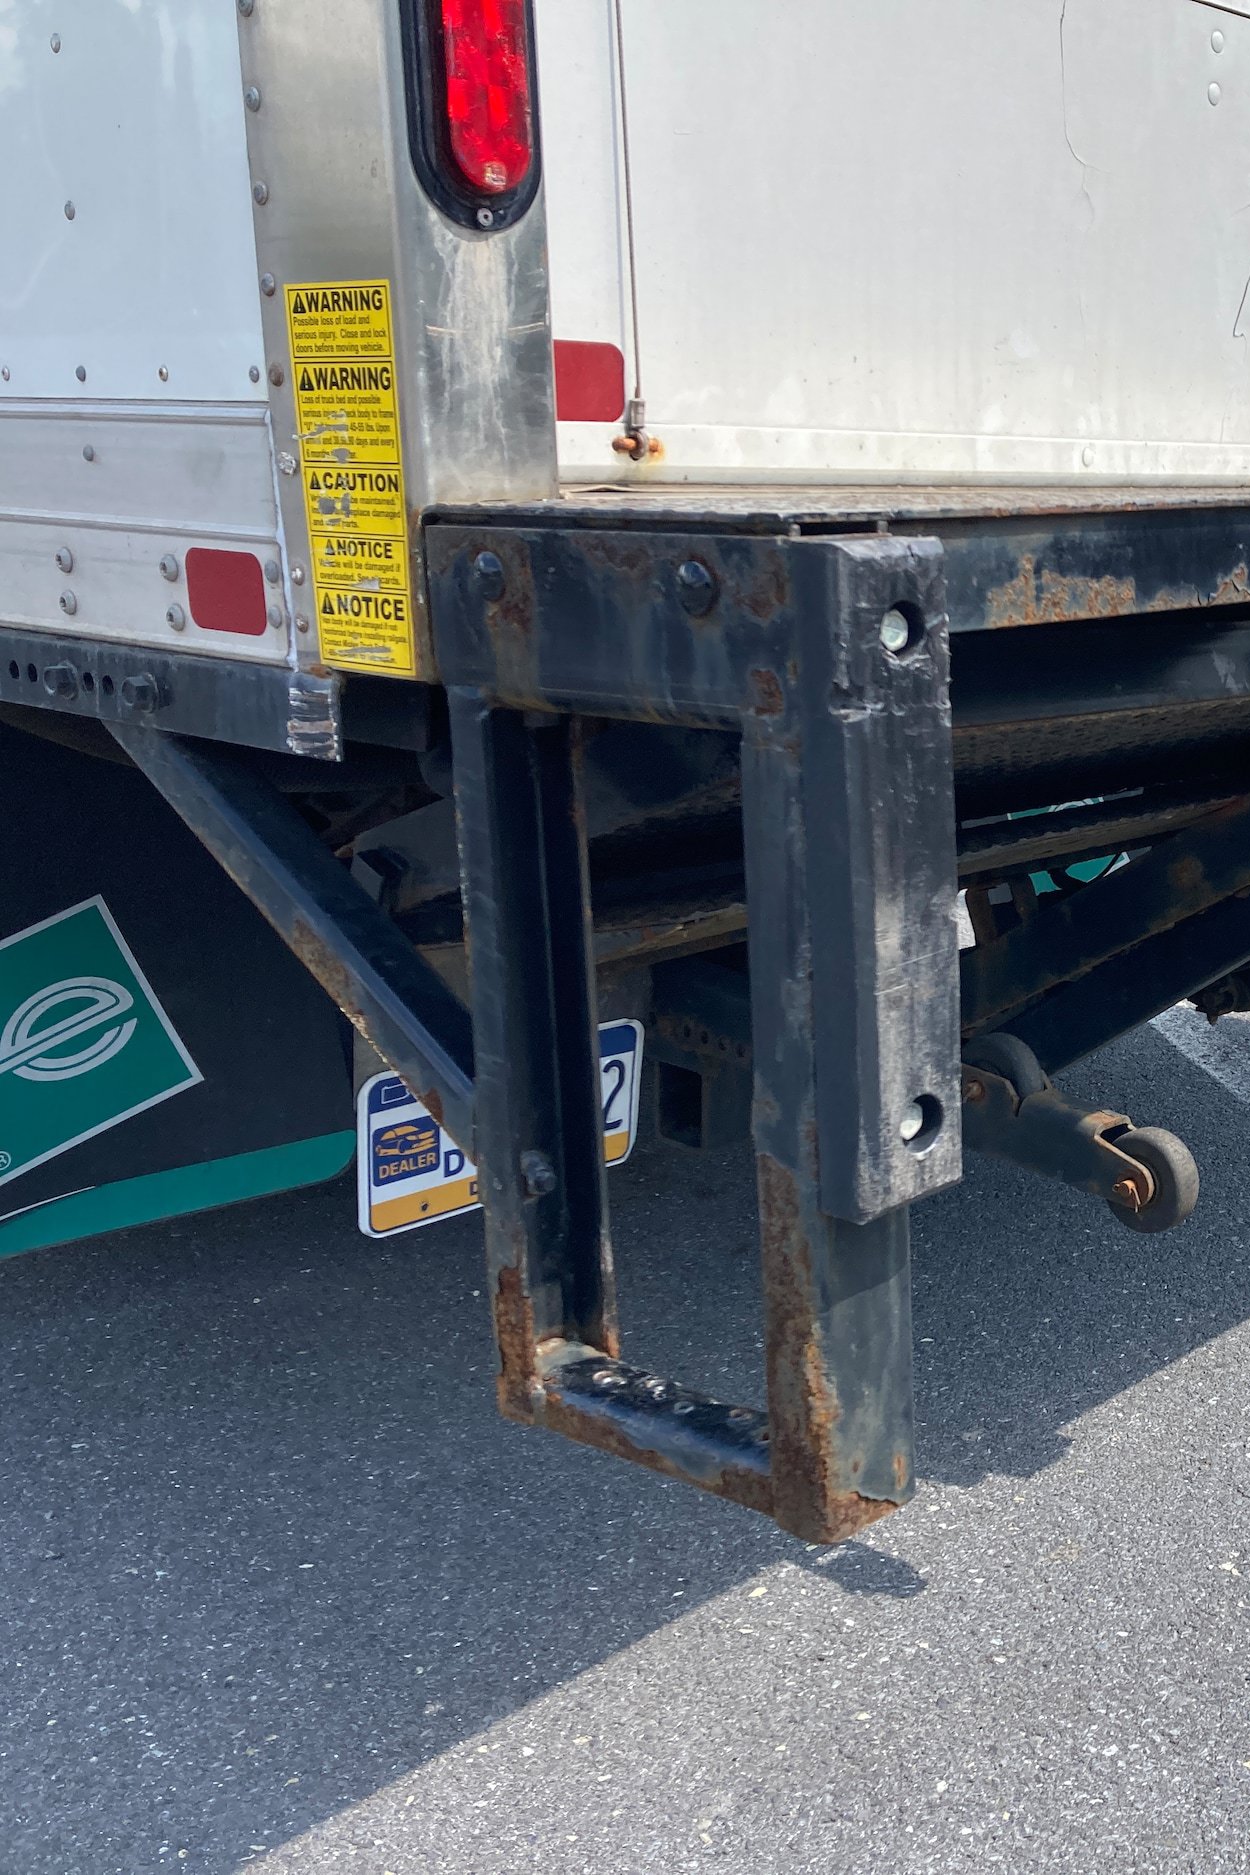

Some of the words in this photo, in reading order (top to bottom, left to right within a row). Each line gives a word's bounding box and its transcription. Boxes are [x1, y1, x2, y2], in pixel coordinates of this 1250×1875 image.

[305, 289, 383, 313] WARNING
[293, 316, 319, 326] Possible
[320, 315, 334, 325] loss
[335, 315, 342, 325] of
[342, 314, 357, 325] load
[358, 314, 370, 324] and
[294, 331, 317, 340] serious
[318, 330, 337, 342] injury.
[340, 328, 359, 339] Close
[360, 328, 372, 338] and
[373, 327, 386, 338] lock
[295, 342, 314, 353] doors
[314, 342, 334, 353] before
[336, 343, 359, 355] moving
[360, 341, 385, 352] vehicle.
[313, 366, 391, 391] WARNING
[315, 393, 321, 404] of
[347, 394, 357, 404] and
[323, 472, 399, 493] CAUTION
[337, 539, 393, 559] NOTICE
[336, 593, 405, 622] NOTICE
[378, 1152, 437, 1180] DEALER
